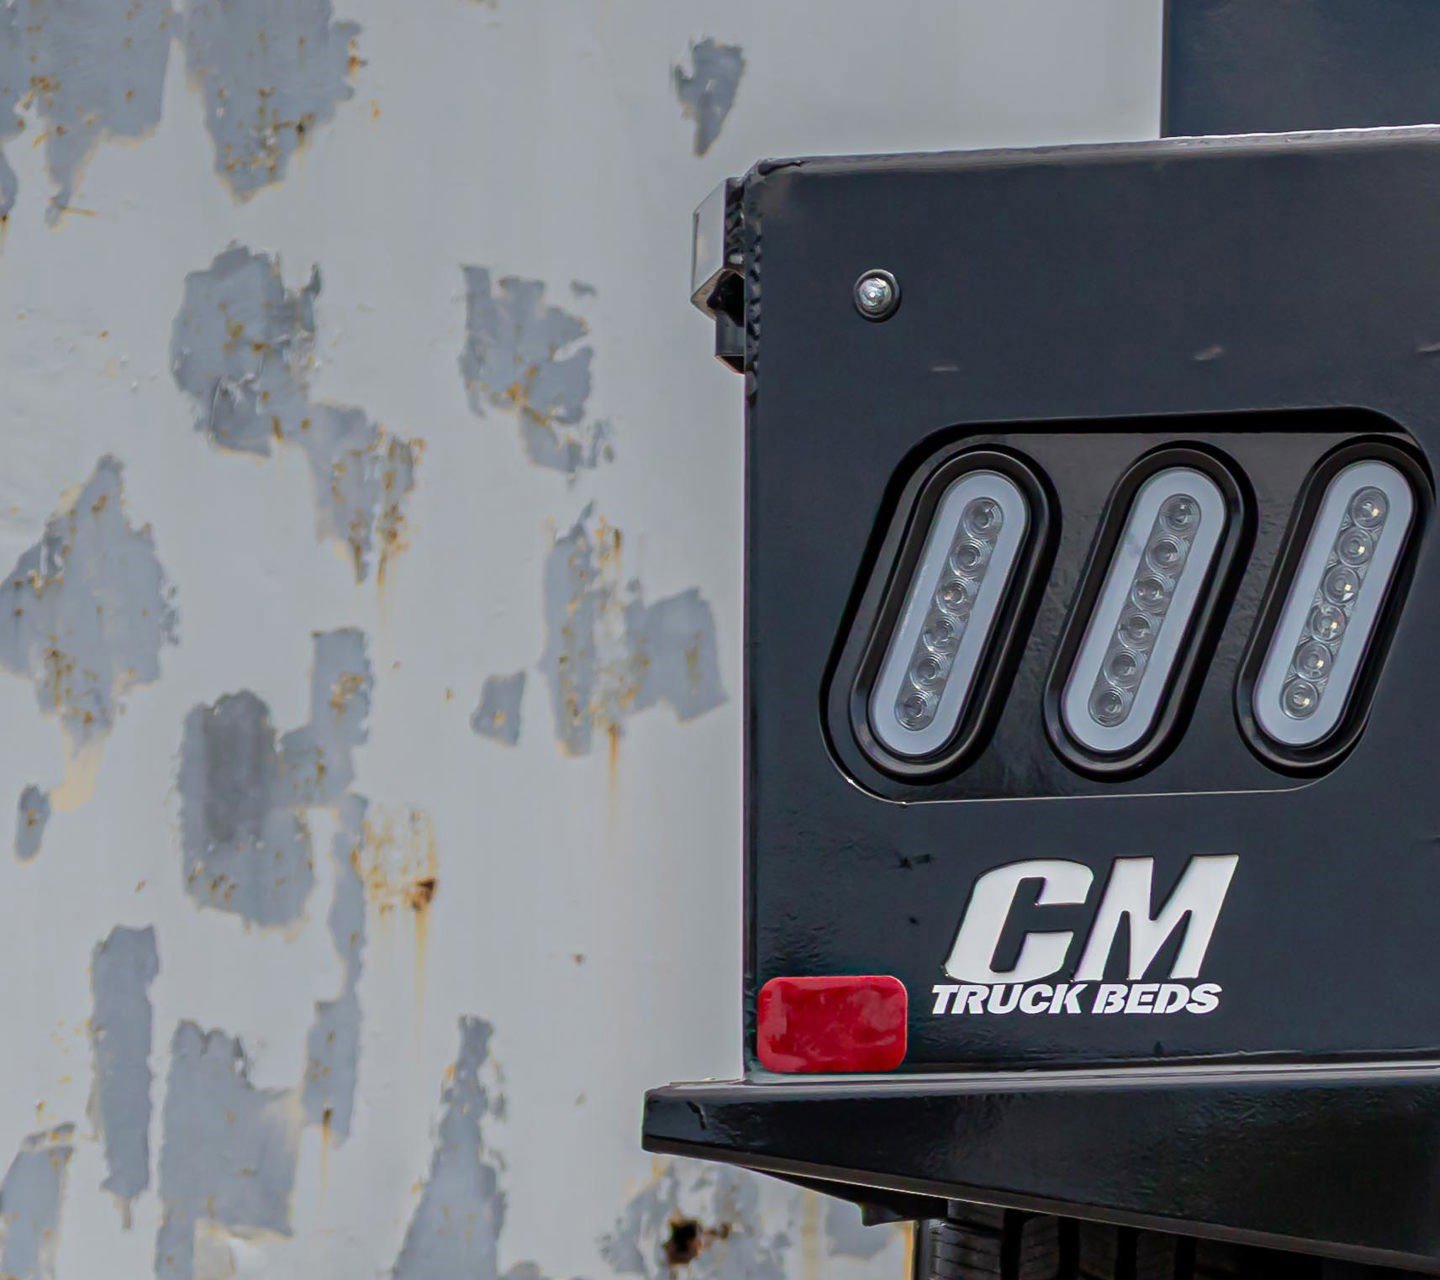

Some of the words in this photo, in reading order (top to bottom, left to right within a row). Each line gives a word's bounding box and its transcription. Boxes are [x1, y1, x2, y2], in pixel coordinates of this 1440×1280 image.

[943, 853, 1240, 985] CM
[931, 983, 1088, 1015] TRUCK
[1091, 982, 1223, 1014] BEDS
